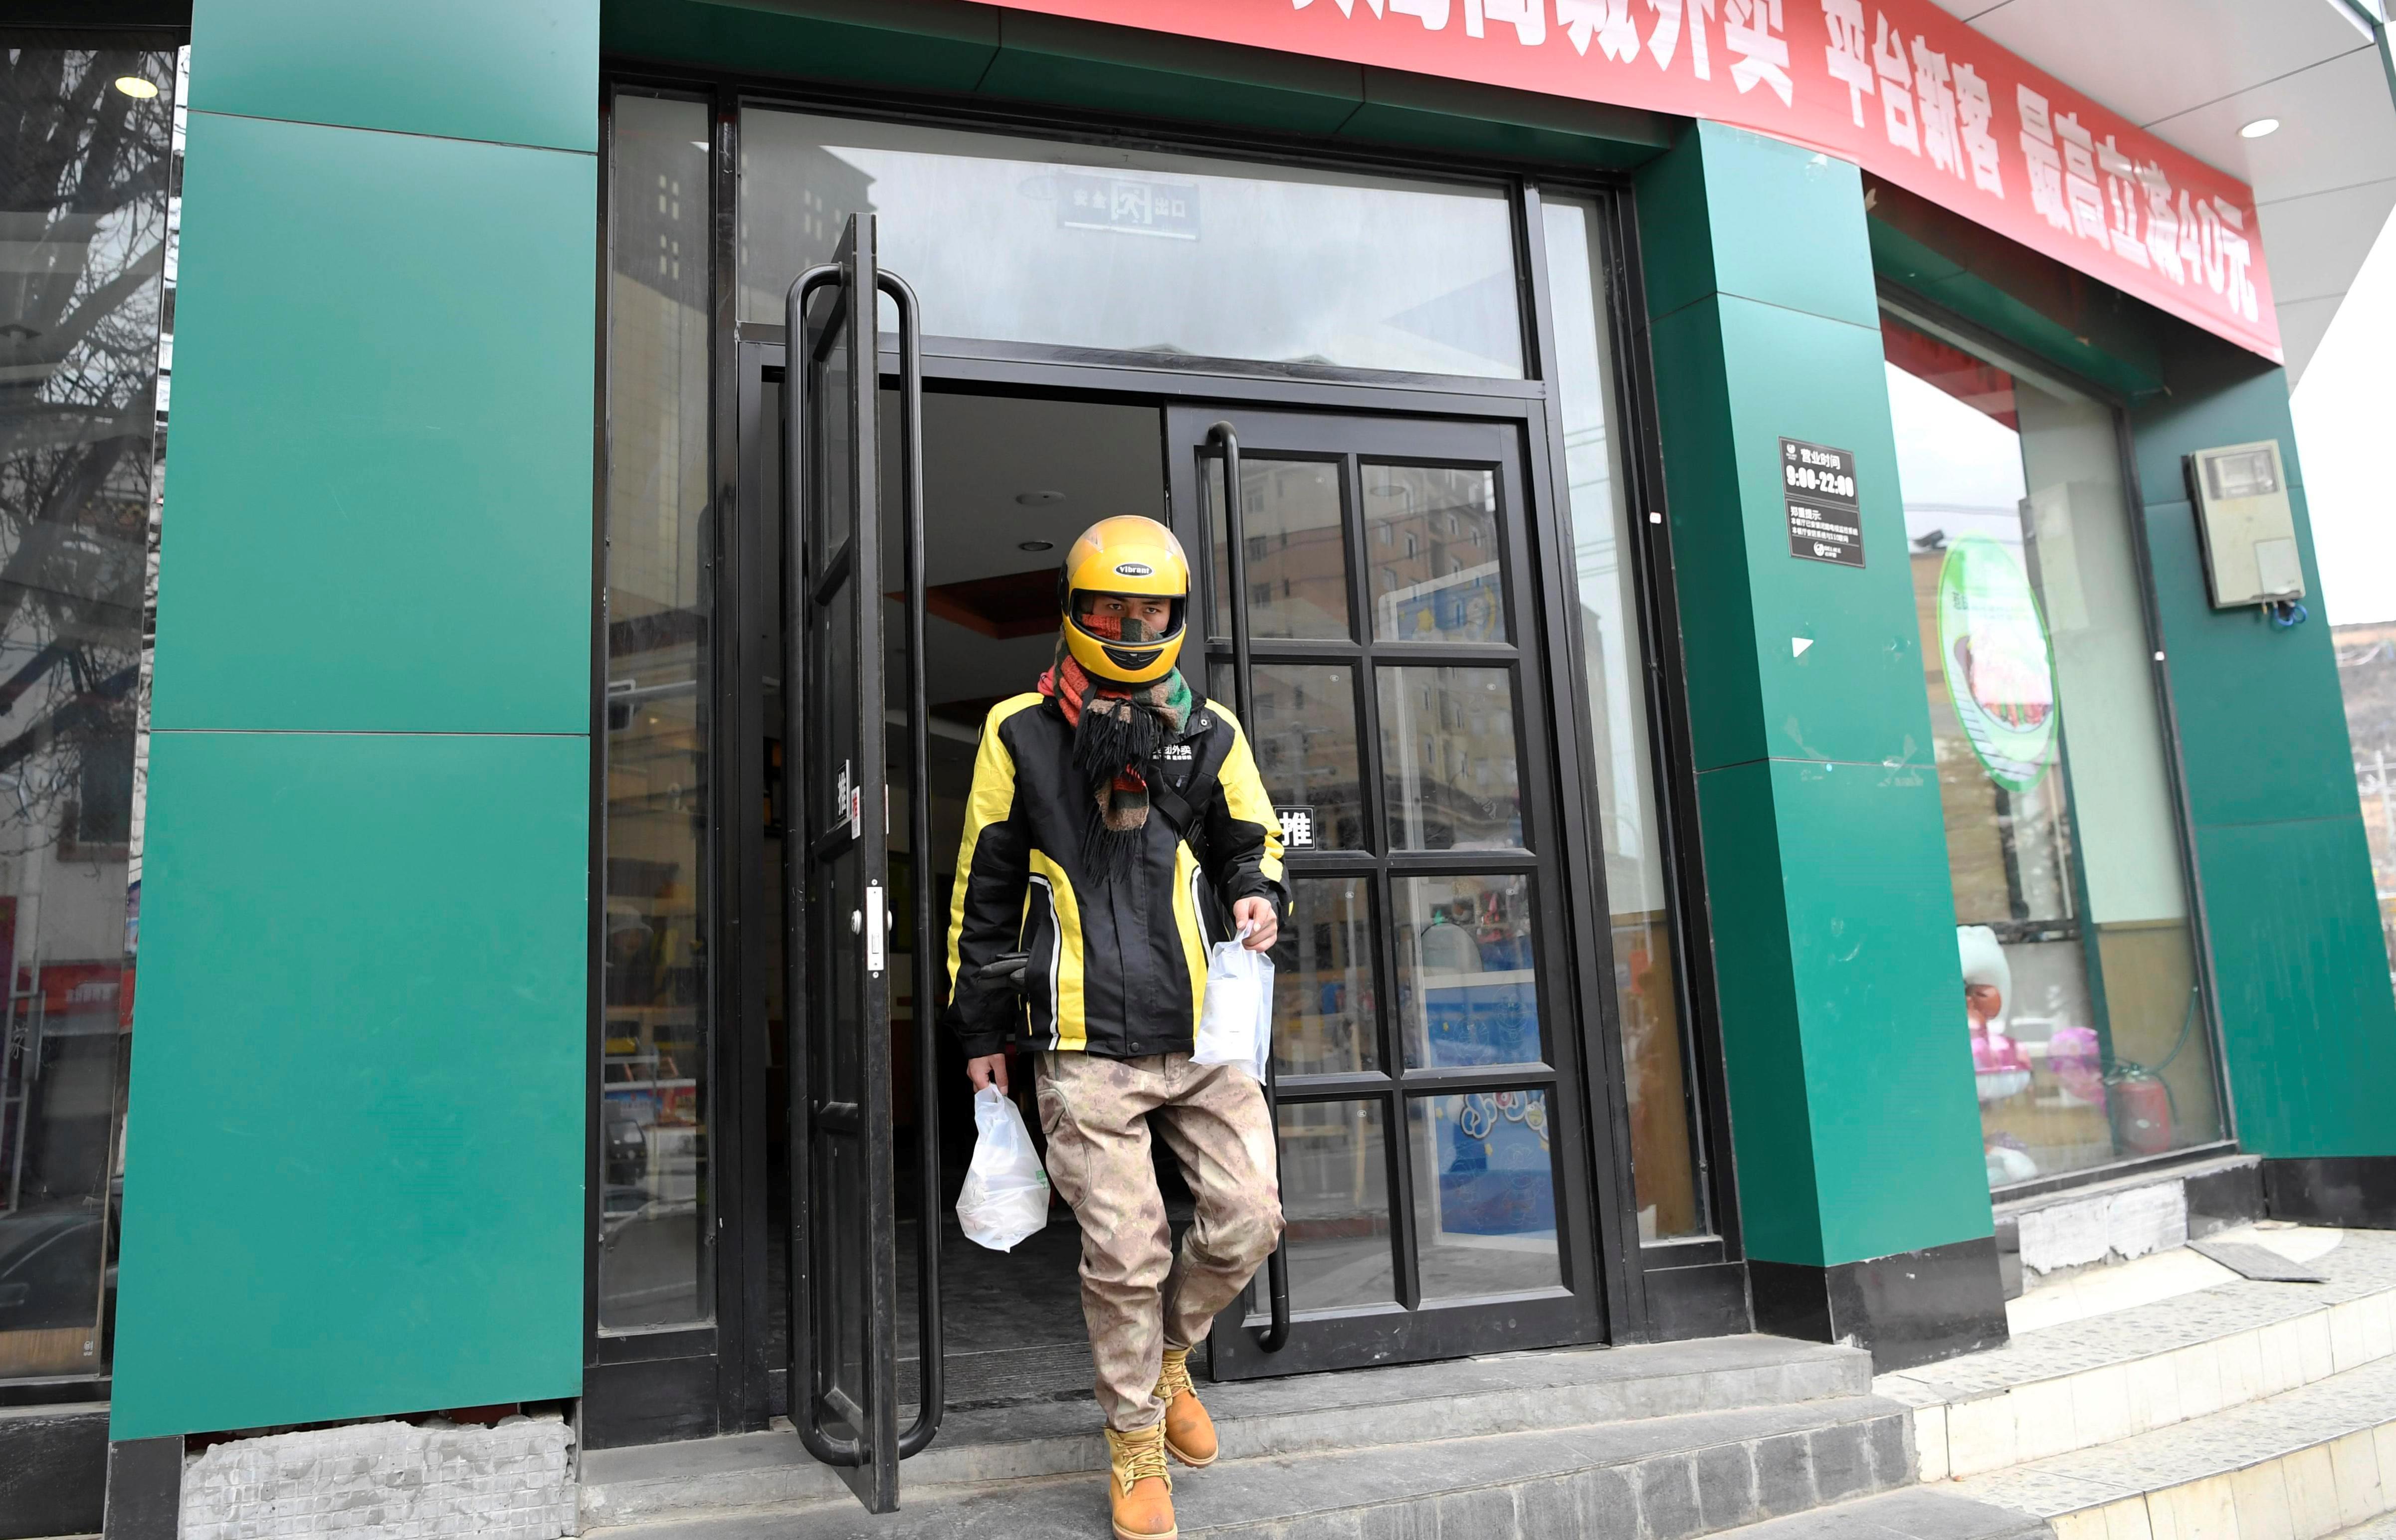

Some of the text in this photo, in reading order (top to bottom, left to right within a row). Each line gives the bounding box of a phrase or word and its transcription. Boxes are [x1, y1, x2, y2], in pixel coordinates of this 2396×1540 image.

[1821, 0, 2005, 199] 平台新客
[2017, 83, 2259, 323] 最高立减40元
[1800, 448, 1841, 470] 营业时间
[1786, 465, 1854, 497] 9:00-22:00
[1119, 566, 1150, 574] Vibrant
[1278, 811, 1313, 846] 推
